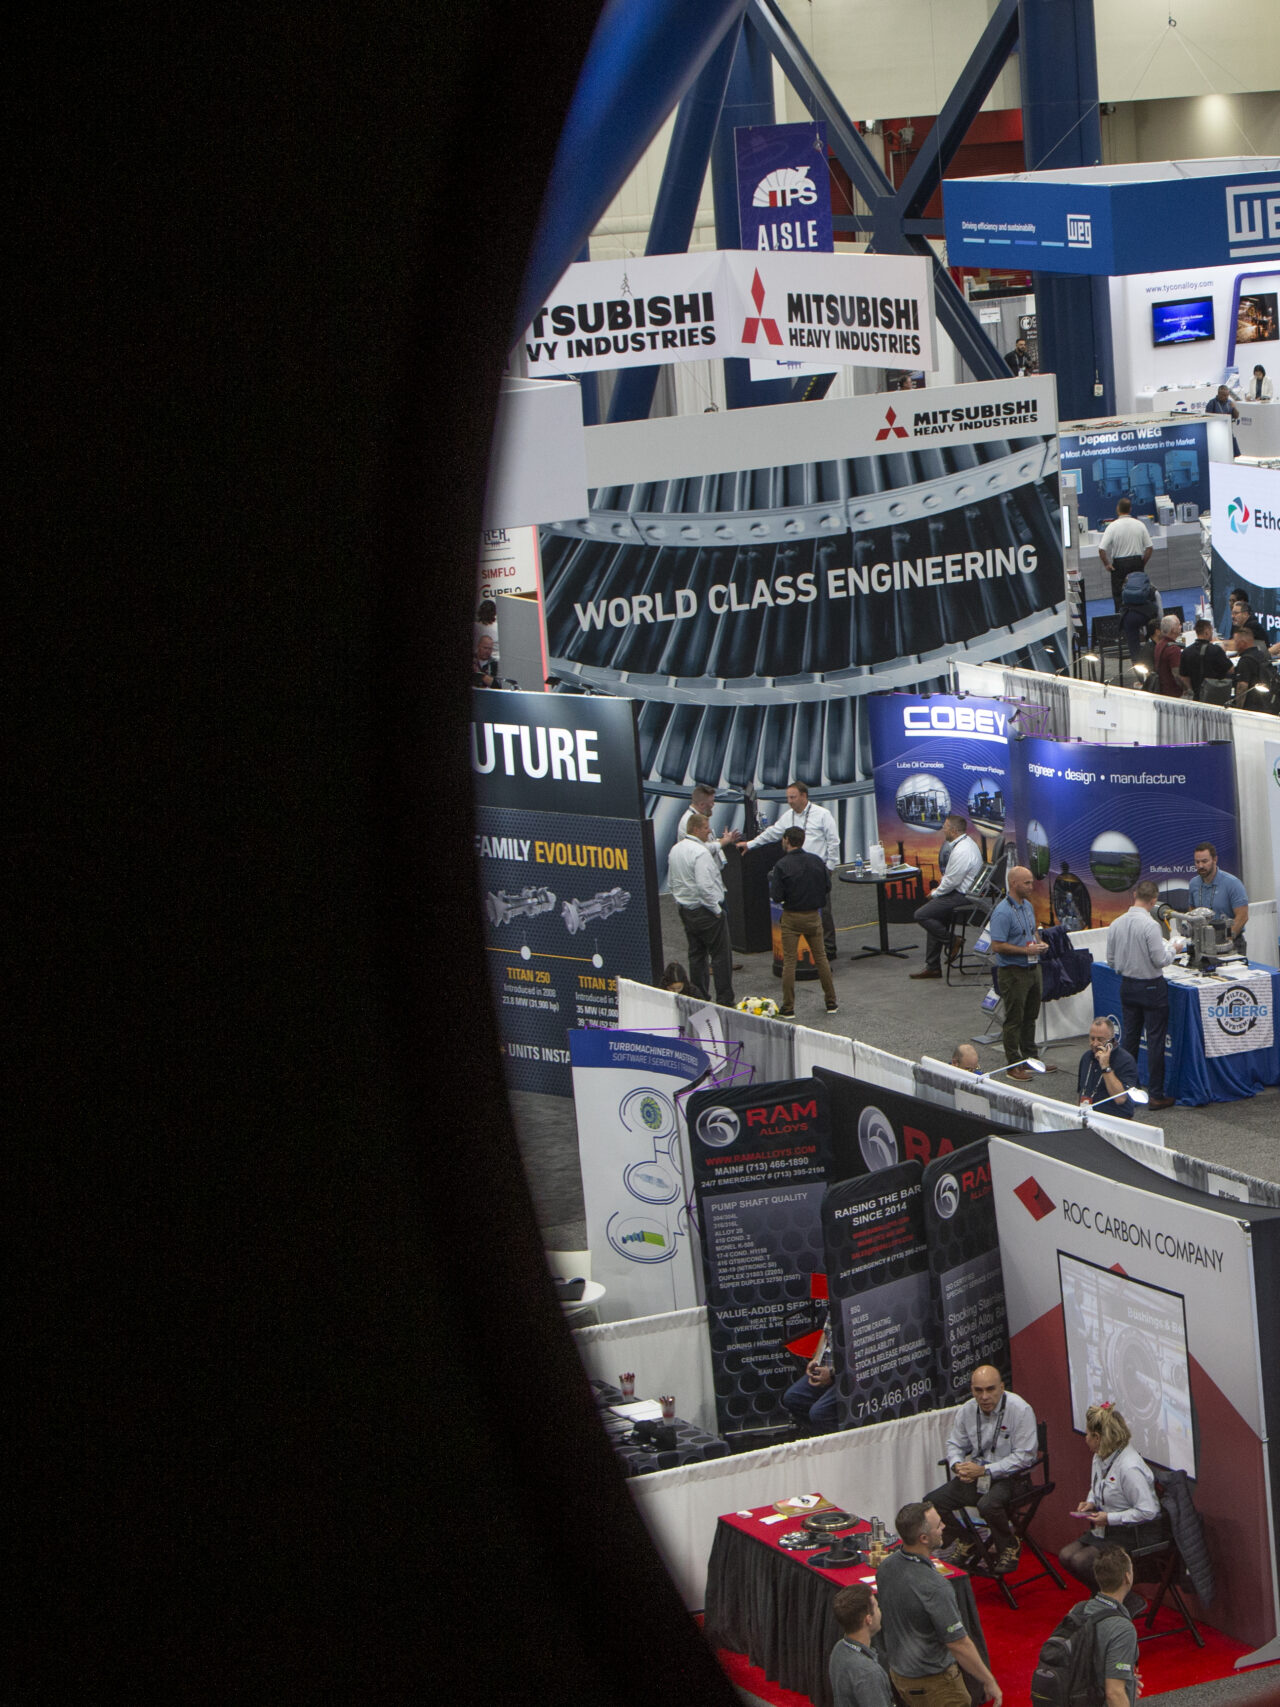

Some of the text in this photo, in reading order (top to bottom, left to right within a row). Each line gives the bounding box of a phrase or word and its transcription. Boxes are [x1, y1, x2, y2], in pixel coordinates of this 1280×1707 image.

[757, 220, 818, 251] AISLE
[787, 292, 920, 331] MITSUBISHI
[566, 325, 717, 359] INDUSTRIES
[788, 328, 921, 356] HEAVY INDUSTRIES
[913, 399, 1038, 427] MITSUBISHI
[913, 413, 1039, 437] HEAVY INDUSTRIES
[1078, 427, 1162, 446] Depend on WEG
[1065, 450, 1081, 459] Most
[1081, 447, 1110, 457] Advanced
[1111, 445, 1137, 453] Induction
[1138, 442, 1159, 451] Motors
[1175, 438, 1196, 446] Market
[481, 566, 516, 580] SIMFLO
[574, 544, 1039, 632] WORLD CLASS ENGINEERING
[903, 706, 1006, 735] COBEY
[472, 722, 602, 783] UTURE
[1028, 763, 1187, 785] engineer design manufacture
[534, 840, 629, 871] EVOLUTION
[506, 967, 551, 984] TITAN 250
[578, 975, 606, 990] TITAN
[503, 983, 535, 996] Introduced
[575, 991, 608, 1004] Introduced
[515, 998, 528, 1007] MW
[584, 1005, 598, 1015] MW
[1207, 1005, 1268, 1018] SOLBERG
[508, 1043, 540, 1060] UNITS
[609, 1041, 674, 1057] TURBOMACHINERY
[612, 1053, 678, 1070] SOFTWARE SERVICES
[746, 1100, 817, 1127] RAM
[759, 1123, 809, 1136] ALLOYS
[705, 1145, 816, 1167] WWW.RAMALLOYS.COM
[714, 1166, 744, 1176] MAIN#
[746, 1162, 768, 1174] (713)
[701, 1180, 716, 1188] 24/7
[718, 1174, 766, 1186] EMERGENCY
[774, 1171, 791, 1179] (713)
[711, 1193, 808, 1212] PUMP SHAFT QUALITY
[834, 1184, 922, 1219] RAISING THE BAR
[852, 1201, 908, 1227] SINCE 2014
[1063, 1199, 1224, 1273] ROC CARBON COMPANY
[851, 1258, 886, 1275] EMERGENCY
[719, 1281, 740, 1289] SUPER
[716, 1304, 784, 1320] VALUE-ADDED
[948, 1303, 978, 1326] Stocking
[1127, 1306, 1164, 1329] Bushings
[734, 1323, 769, 1333] (VERTICAL
[949, 1329, 956, 1341] &
[956, 1321, 978, 1339] Nickel
[726, 1341, 752, 1351] BORING
[950, 1323, 1004, 1357] Close Tolerance
[741, 1352, 783, 1363] CENTERLESS
[876, 1348, 898, 1361] RELEASE
[952, 1355, 974, 1373] Shafts
[758, 1368, 772, 1376] SAW
[856, 1360, 898, 1382] SAME DAY ORDER
[857, 1377, 932, 1418] 713.466.1890
